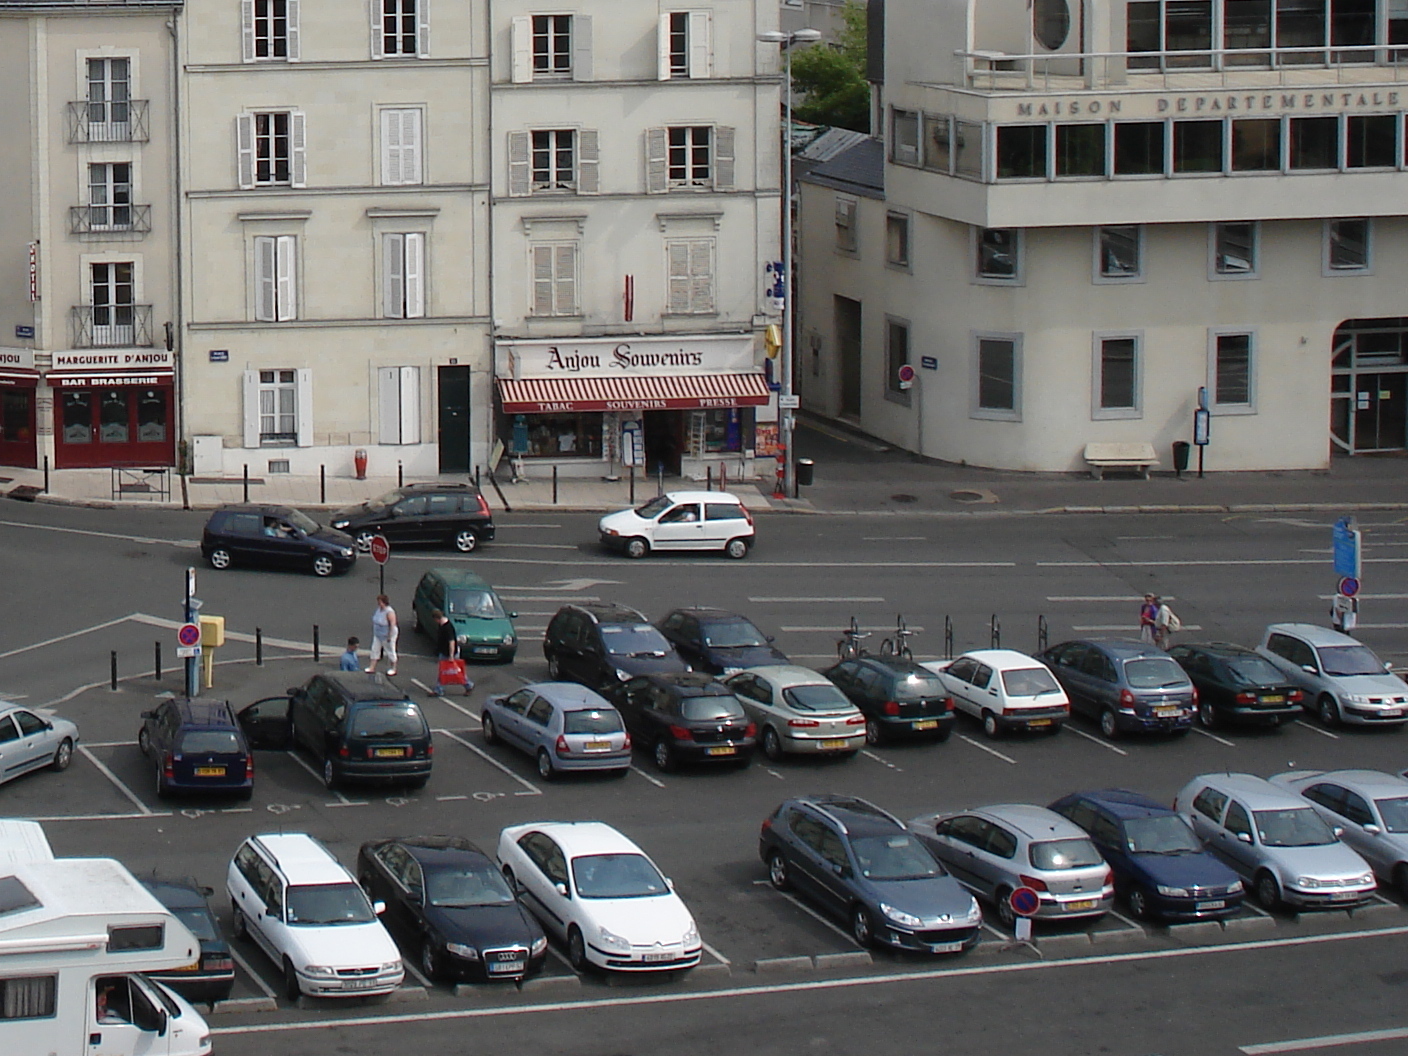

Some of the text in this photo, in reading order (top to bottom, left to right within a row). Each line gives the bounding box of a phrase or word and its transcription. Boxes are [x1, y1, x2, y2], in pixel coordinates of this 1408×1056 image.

[1017, 91, 1400, 116] MAISON DEPARTEMENTALE
[57, 353, 168, 365] MARGUERITE D'ANJOU
[545, 343, 704, 372] Anjou Souvenirs
[61, 377, 158, 386] BAR BRASSERIE
[538, 397, 738, 412] TABAC SOUVENIRS PRESSE
[372, 543, 387, 555] STOP
